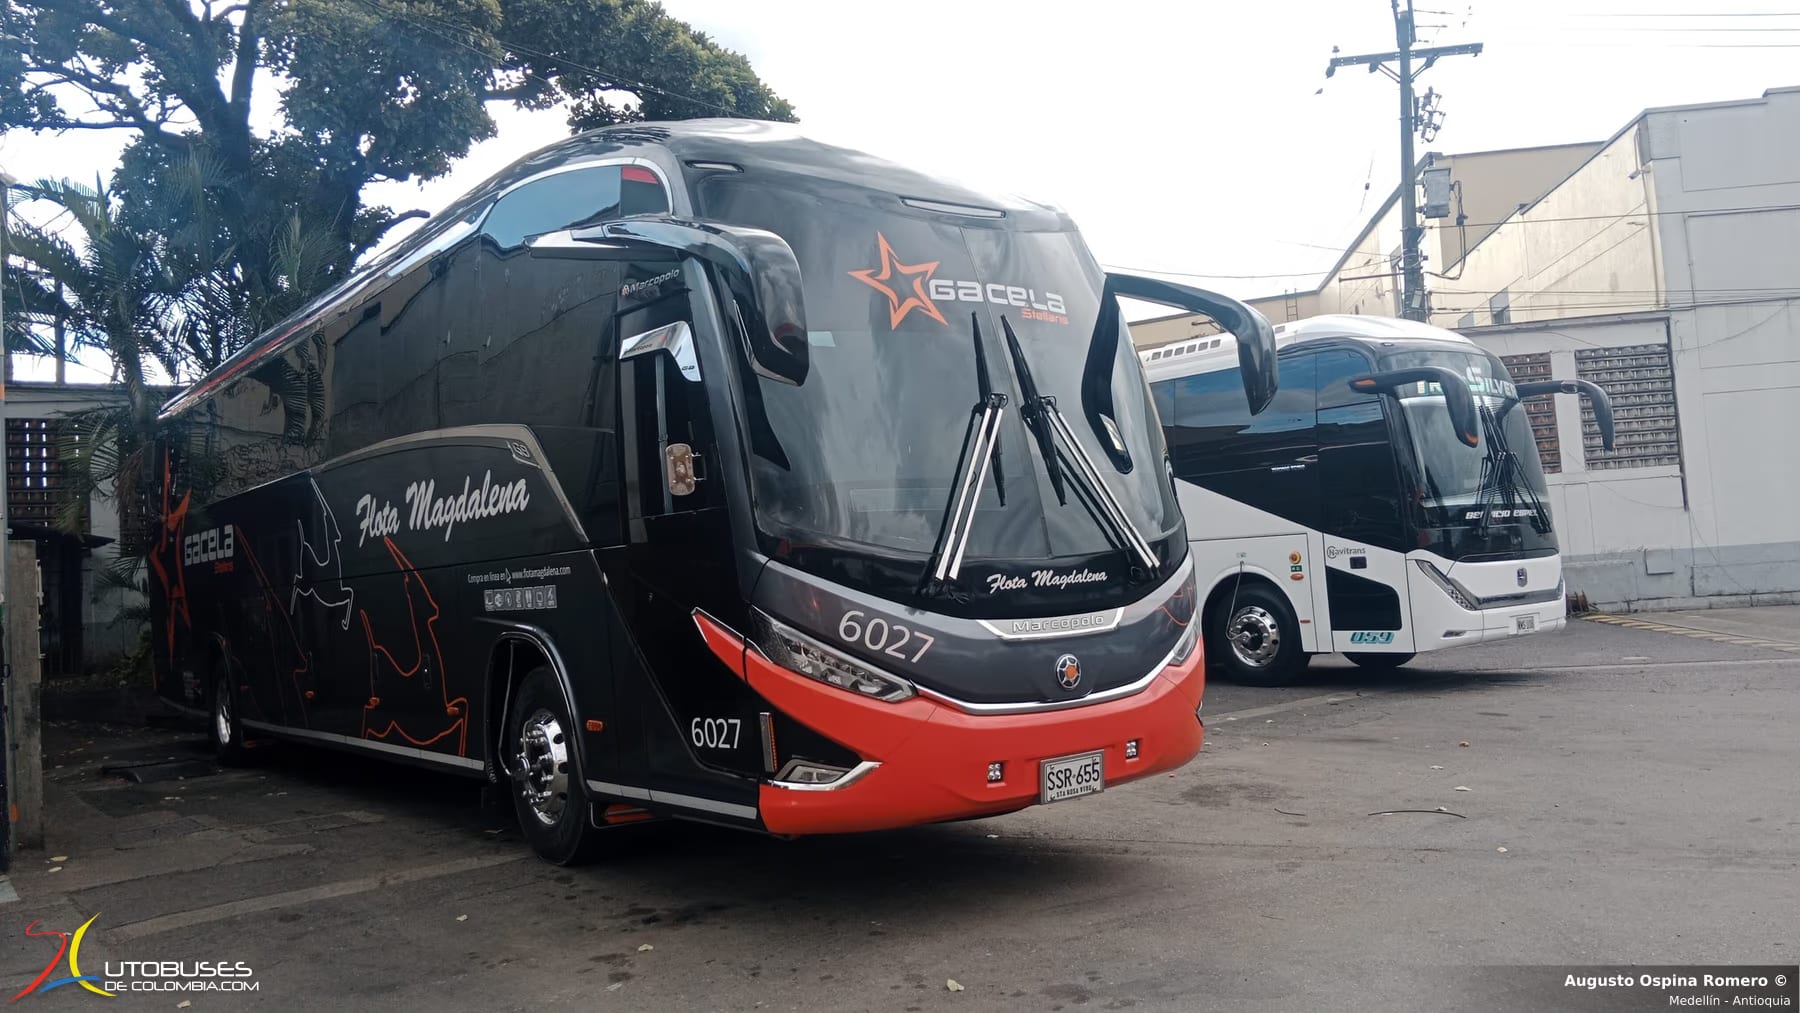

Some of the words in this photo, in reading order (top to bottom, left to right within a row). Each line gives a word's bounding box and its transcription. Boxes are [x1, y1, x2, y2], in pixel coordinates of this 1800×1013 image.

[630, 268, 680, 294] Marcopolo
[356, 494, 401, 548] Flota
[406, 469, 531, 542] Magdalena
[986, 572, 1027, 594] Flota
[1031, 568, 1108, 587] Magdalena
[838, 609, 935, 664] 6027
[1011, 615, 1105, 634] Marcopolo
[1350, 631, 1395, 645] 059
[691, 717, 741, 749] 6027
